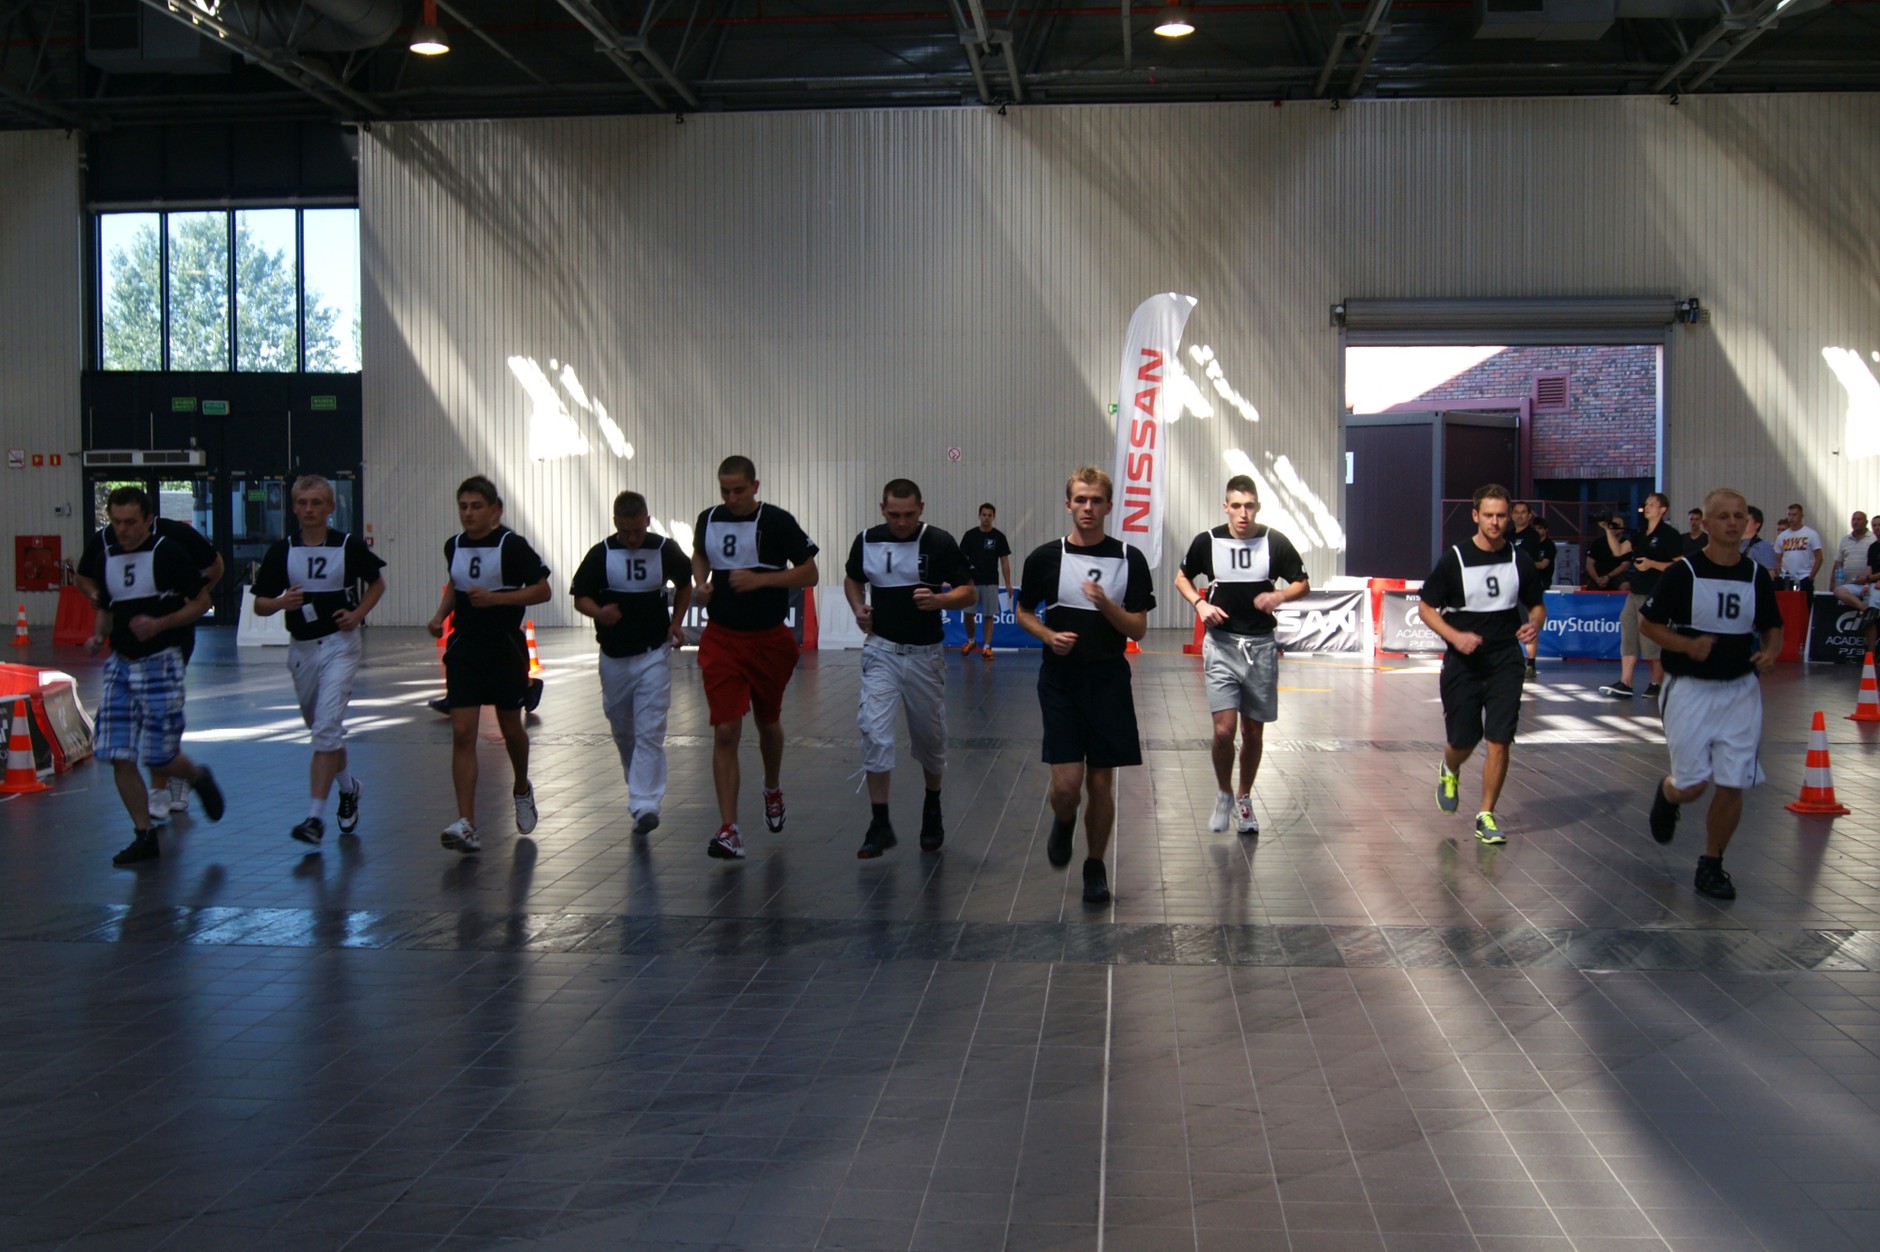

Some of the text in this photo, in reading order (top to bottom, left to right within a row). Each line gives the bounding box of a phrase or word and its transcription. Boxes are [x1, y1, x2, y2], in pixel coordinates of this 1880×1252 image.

[998, 104, 1007, 116] 4
[1122, 347, 1164, 533] NISSAN
[723, 534, 736, 557] 8
[307, 557, 326, 579] 12
[469, 556, 481, 579] 6
[885, 552, 892, 573] 1
[1230, 548, 1251, 569] 10
[123, 563, 135, 588] 5
[625, 559, 647, 581] 15
[1486, 576, 1500, 597] 9
[1717, 592, 1740, 620] 16
[1276, 610, 1356, 633] SAN
[1543, 617, 1621, 636] layStation
